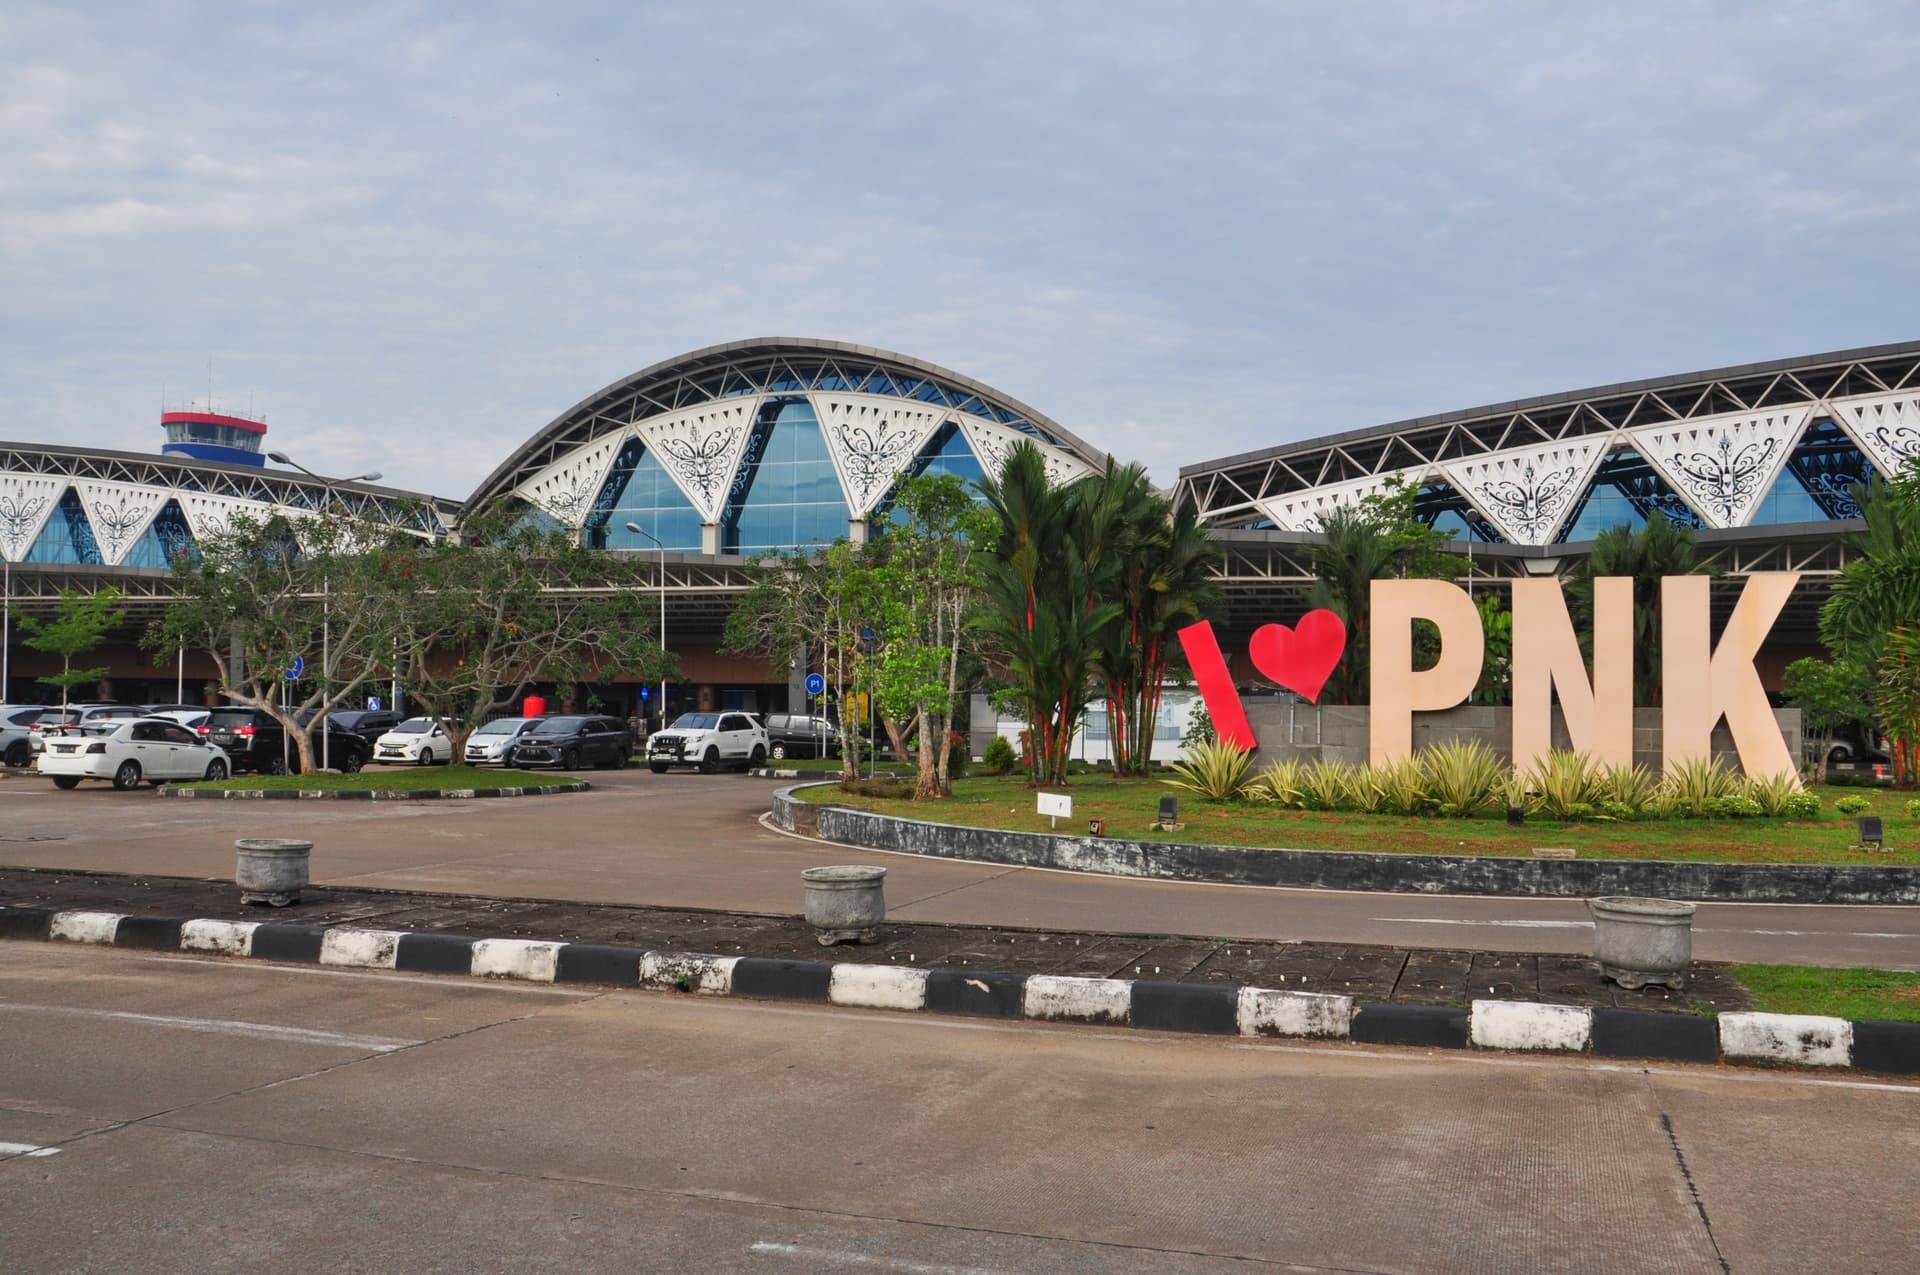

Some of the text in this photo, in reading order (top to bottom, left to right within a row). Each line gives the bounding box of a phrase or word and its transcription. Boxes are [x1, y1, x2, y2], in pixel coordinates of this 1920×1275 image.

[810, 679, 820, 688] P1
[1177, 574, 1804, 793] I PNK
